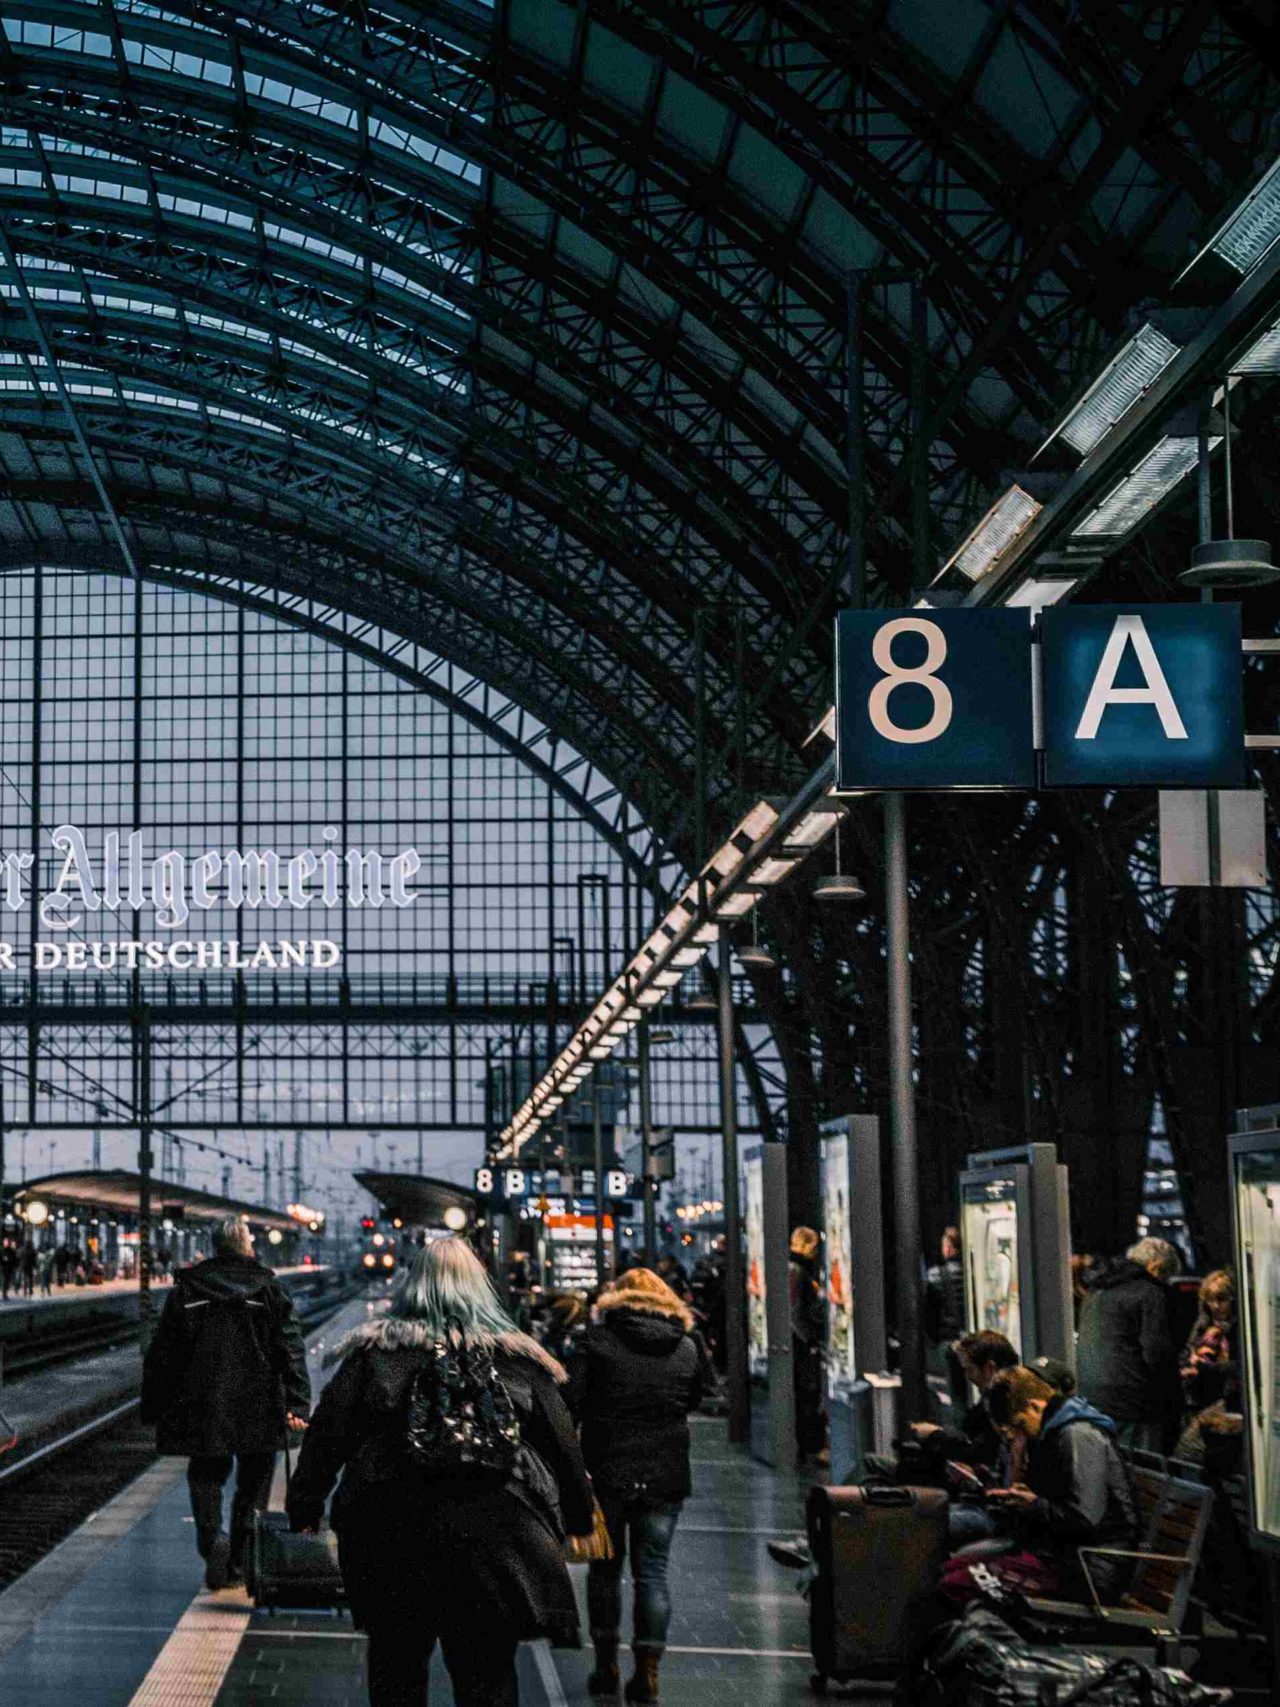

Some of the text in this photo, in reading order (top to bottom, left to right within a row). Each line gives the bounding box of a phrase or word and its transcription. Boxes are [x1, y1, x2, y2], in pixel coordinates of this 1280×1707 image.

[868, 615, 1189, 744] 8 A
[40, 825, 422, 928] Allgemeine
[34, 940, 341, 970] DEUTSCHLAND
[476, 1169, 493, 1193] 8
[505, 1169, 525, 1194] B
[608, 1171, 627, 1196] B
